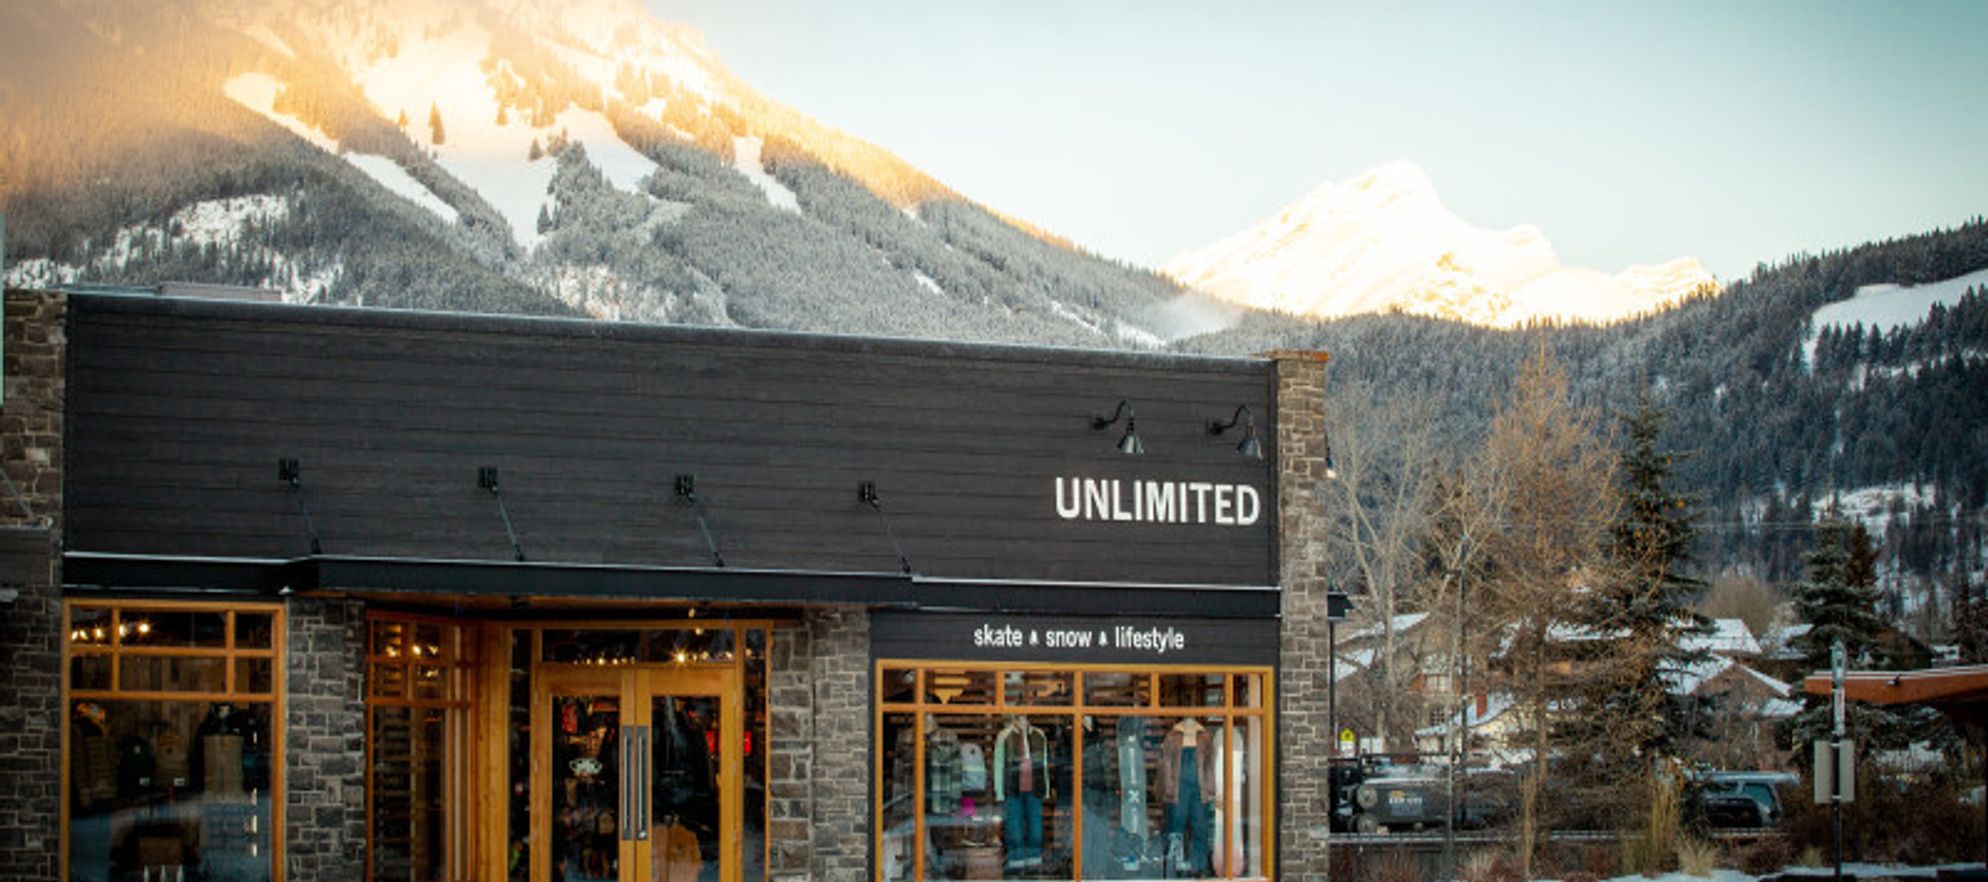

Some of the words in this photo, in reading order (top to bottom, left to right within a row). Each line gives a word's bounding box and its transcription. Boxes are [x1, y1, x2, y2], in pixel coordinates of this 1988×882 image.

[1055, 476, 1260, 525] UNLIMITED
[973, 624, 1023, 647] skate
[1045, 629, 1092, 648] snow
[1115, 626, 1184, 653] lifestyle
